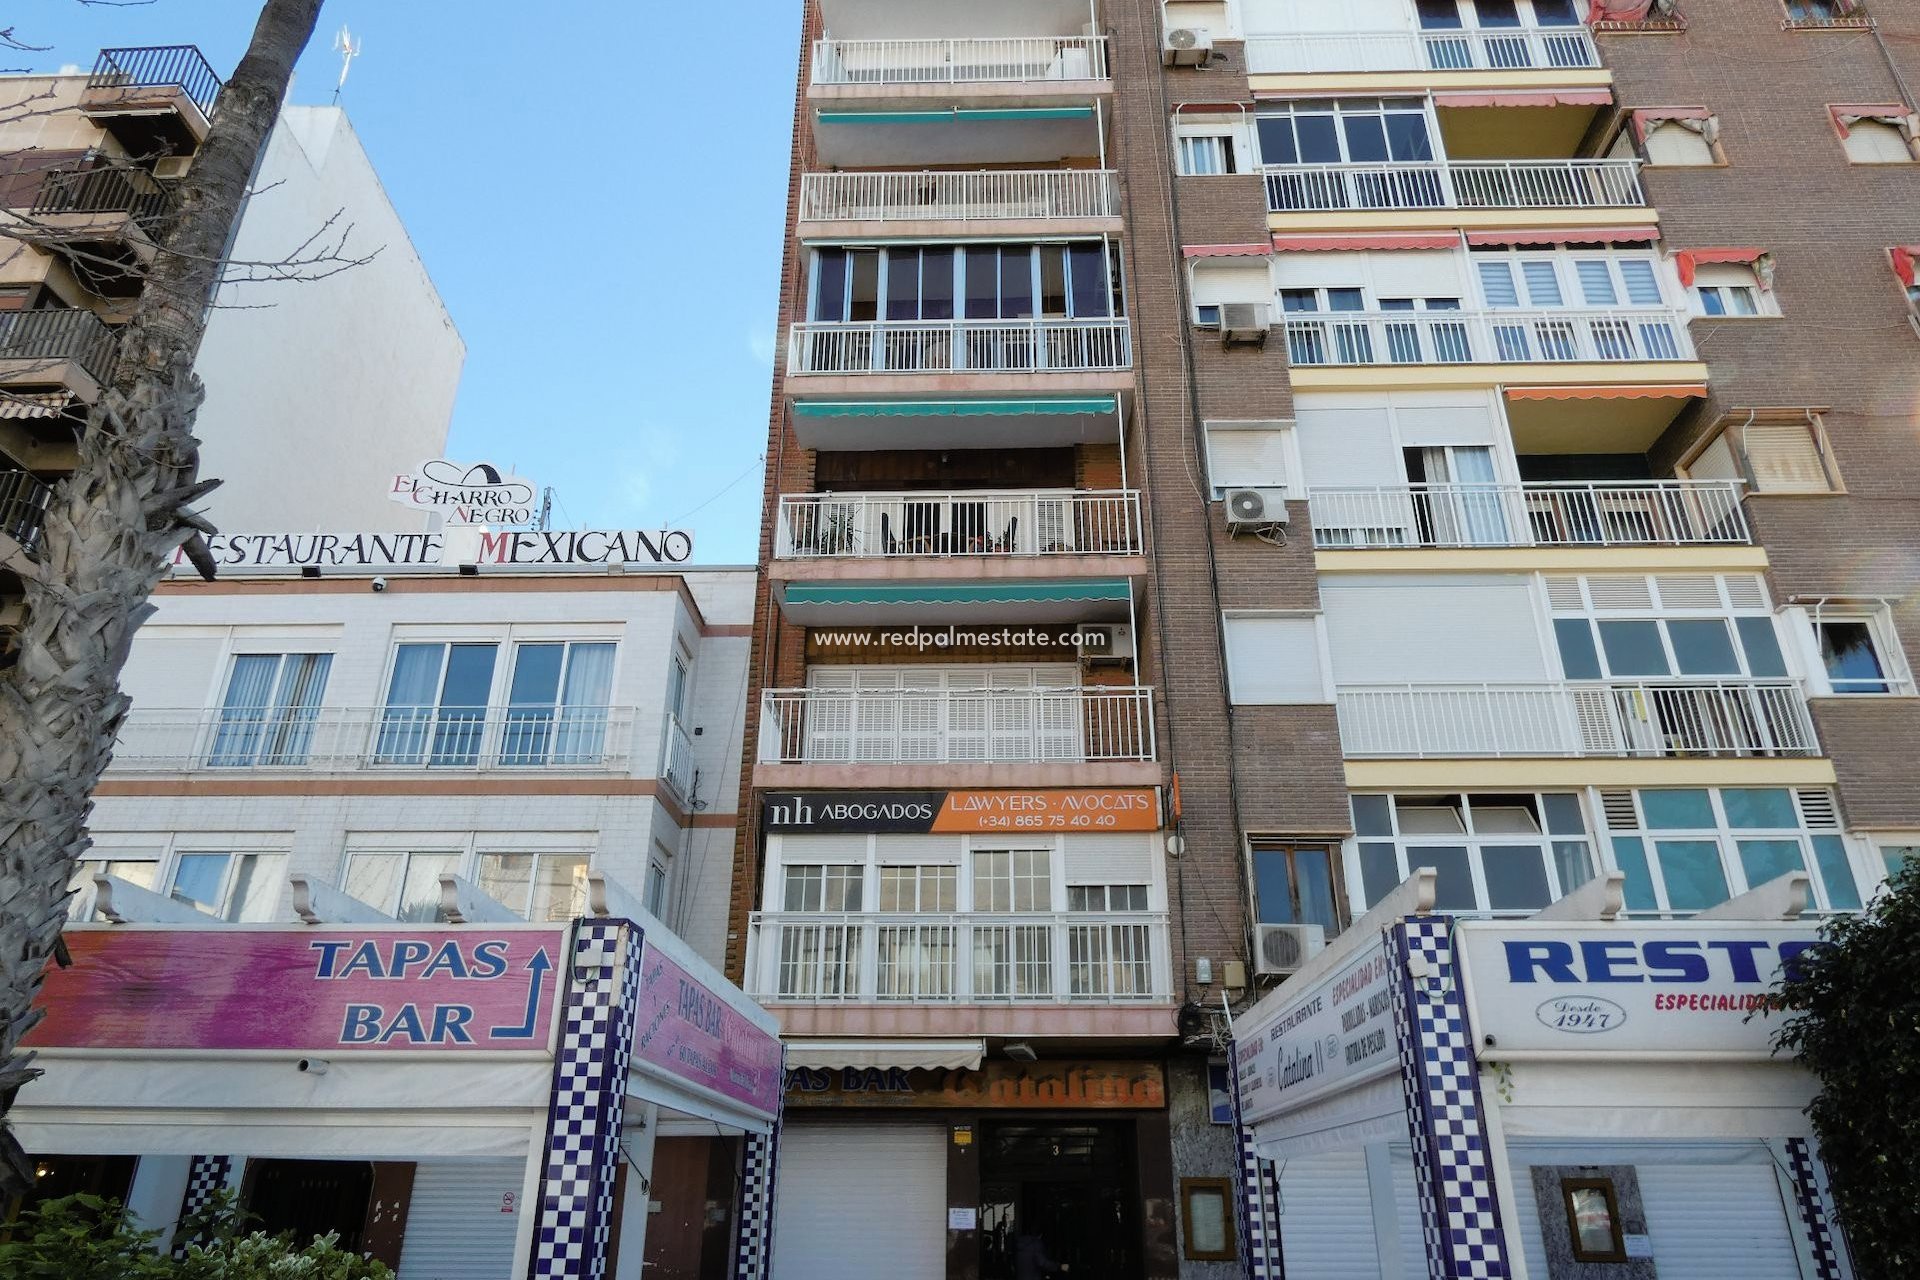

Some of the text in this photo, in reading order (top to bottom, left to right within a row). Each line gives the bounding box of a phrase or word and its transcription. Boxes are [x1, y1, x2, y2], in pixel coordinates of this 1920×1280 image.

[412, 485, 513, 507] CHARRO
[447, 505, 530, 524] NEGRO
[478, 530, 692, 565] MEXICANO
[770, 796, 933, 825] nh ABOGADOS
[951, 795, 1048, 811] LAWYERS
[1061, 794, 1149, 810] AVOCATS
[978, 814, 1117, 828] (+34) 865 75 40 40
[309, 940, 511, 981] TAPAS
[678, 979, 706, 1029] TAPAS
[705, 999, 722, 1039] BAR
[1271, 996, 1323, 1041] RESTAURANTE
[1554, 1001, 1602, 1013] Desde
[338, 1003, 478, 1045] BAR
[1553, 1013, 1610, 1029] 1947
[1278, 1046, 1313, 1092] Catalina
[1052, 1145, 1060, 1157] 3
